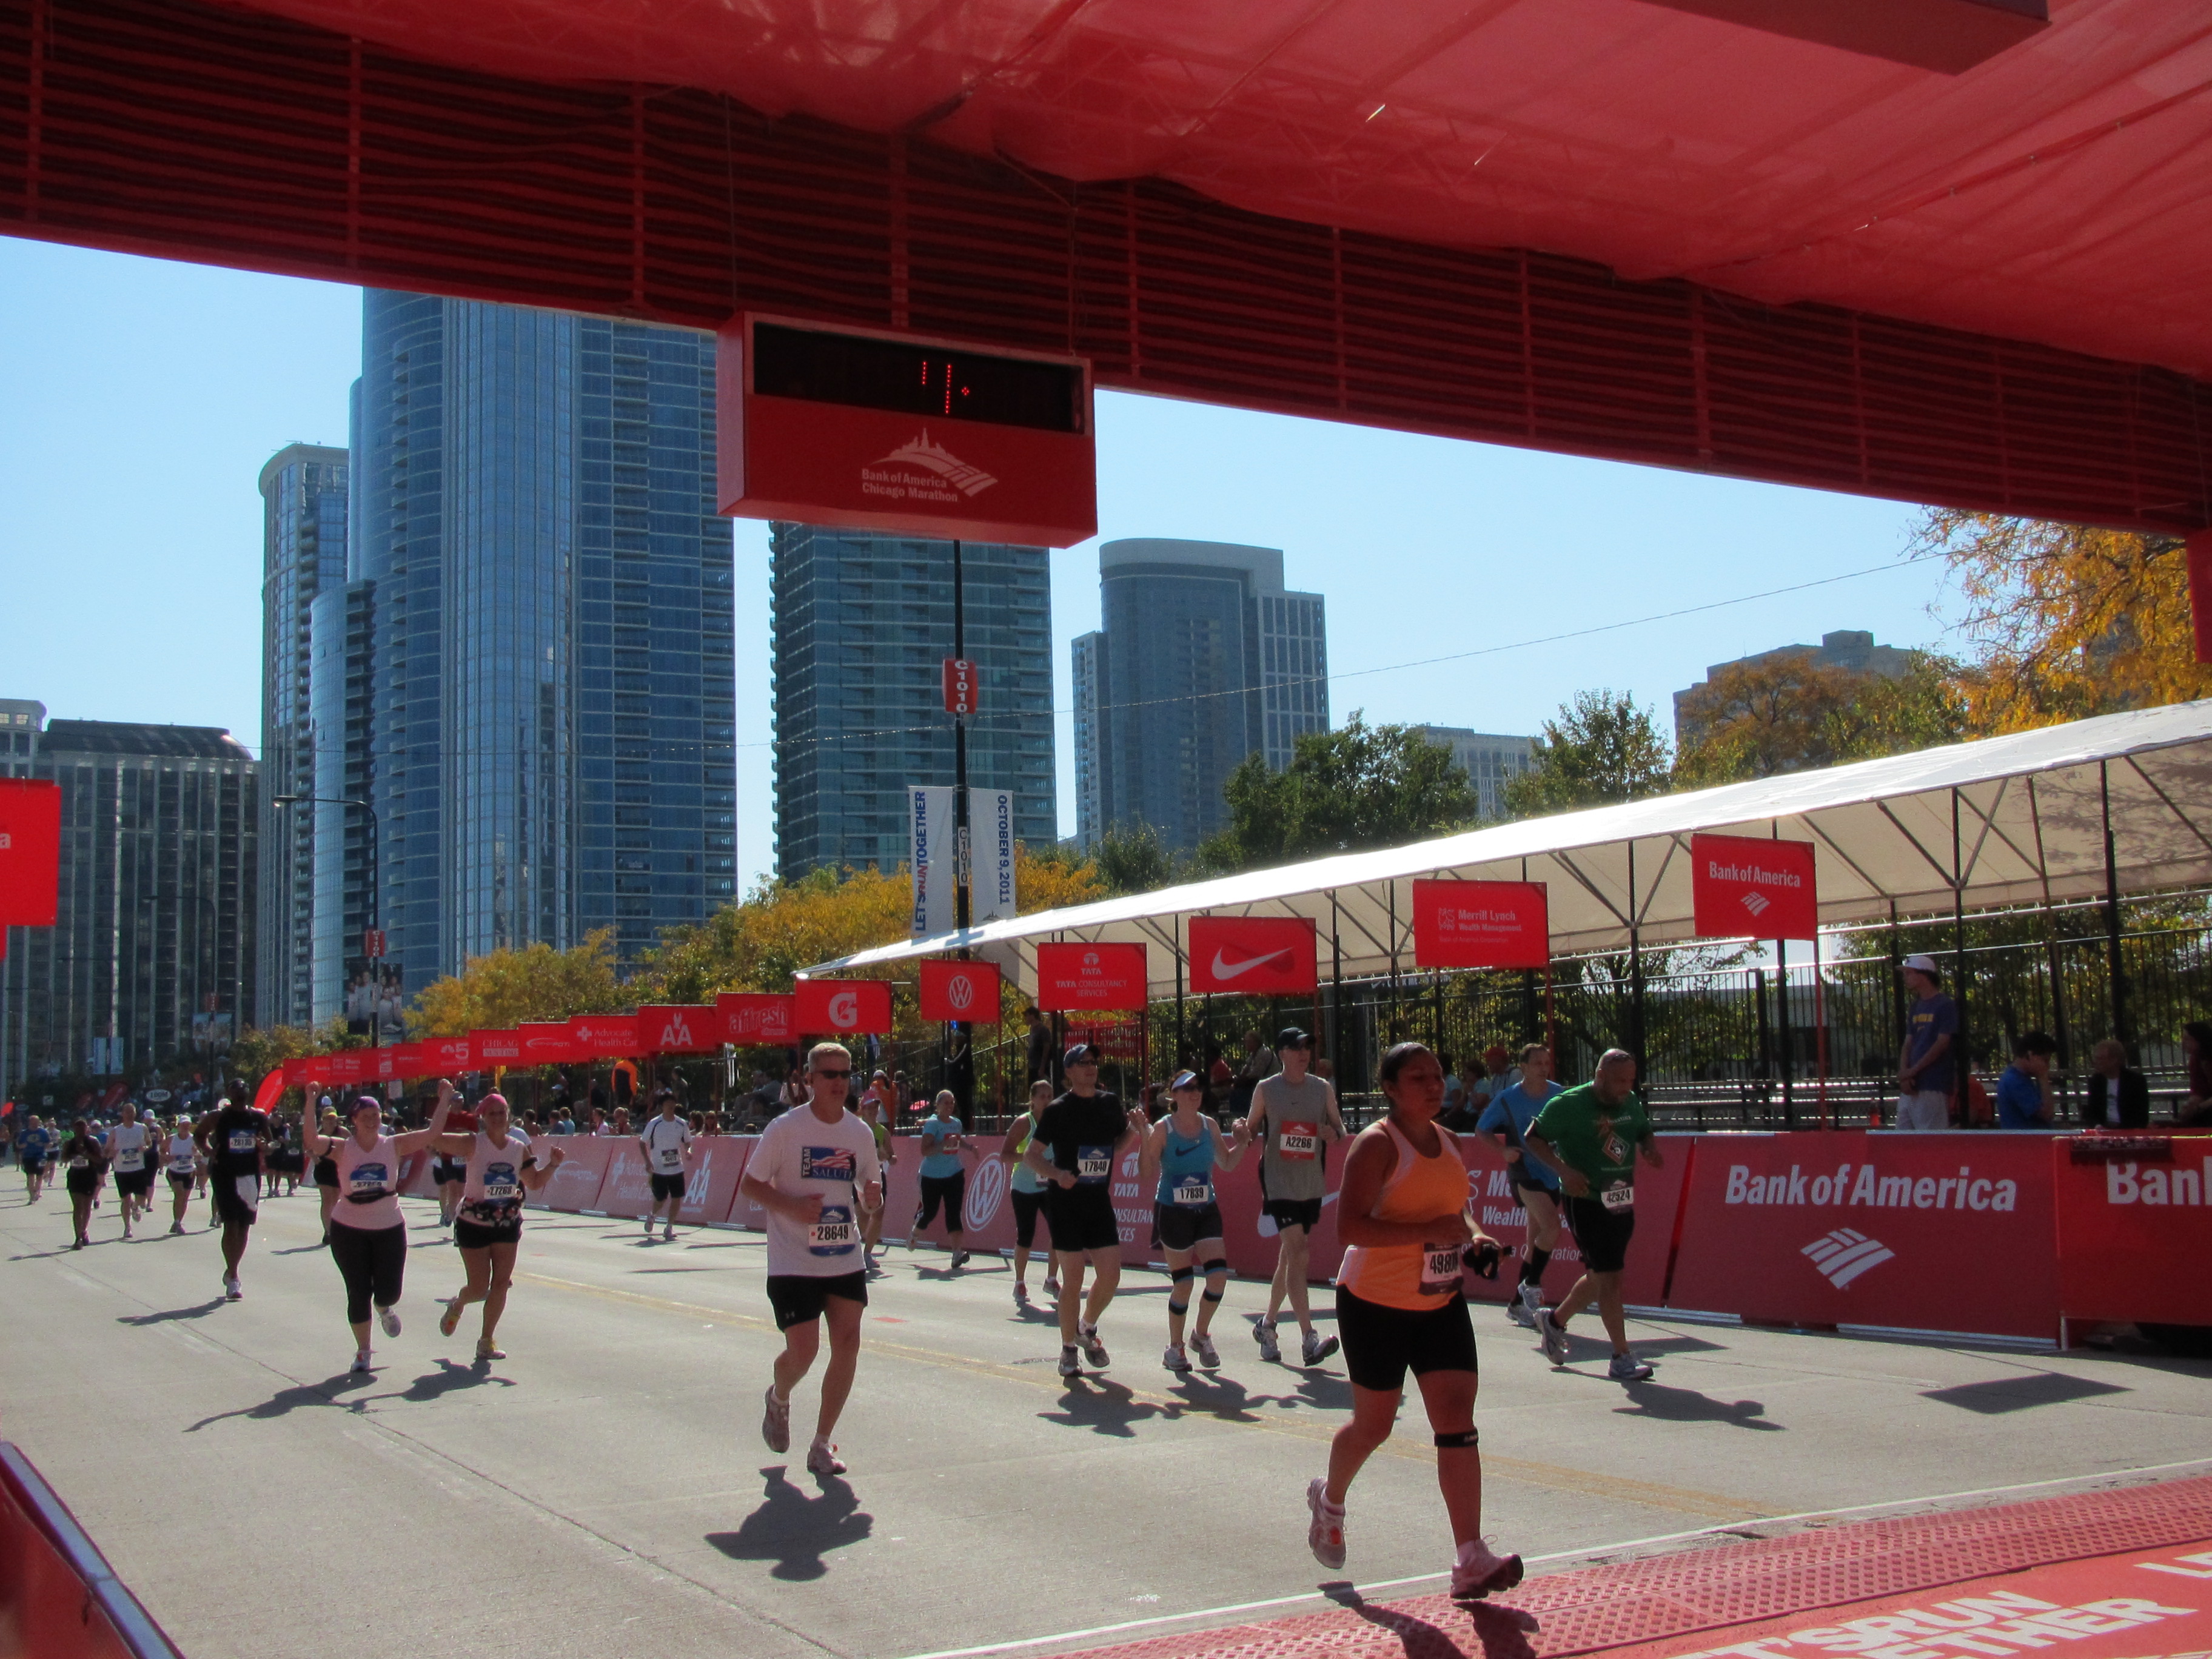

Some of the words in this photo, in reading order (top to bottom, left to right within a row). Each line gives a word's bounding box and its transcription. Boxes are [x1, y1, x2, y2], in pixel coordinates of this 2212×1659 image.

[861, 468, 890, 482] Bank
[890, 472, 902, 483] of
[903, 472, 948, 488] America
[862, 482, 905, 498] Chicago
[908, 486, 958, 502] Marathon
[954, 660, 969, 712] C1010
[997, 794, 1010, 857] OCTOBER
[959, 830, 968, 883] C1010
[1709, 861, 1738, 880] Bank
[1740, 865, 1752, 882] of
[1753, 866, 1801, 888] America
[1458, 910, 1487, 920] Merrill
[1489, 910, 1516, 922] Lynch
[1482, 923, 1522, 932] Management
[729, 1001, 788, 1033] affresh
[455, 1042, 469, 1059] 5
[594, 1038, 622, 1047] Health
[1285, 1136, 1312, 1148] A2266
[803, 1148, 811, 1176] TEAM
[1084, 1161, 1107, 1172] 17840
[1114, 1183, 1139, 1197] TATA
[1179, 1187, 1204, 1199] 17839
[1606, 1189, 1631, 1202] 42524
[1724, 1164, 1808, 1204] Bank
[1811, 1164, 1850, 1205] of
[1848, 1164, 2017, 1211] America
[817, 1225, 849, 1241] 28649
